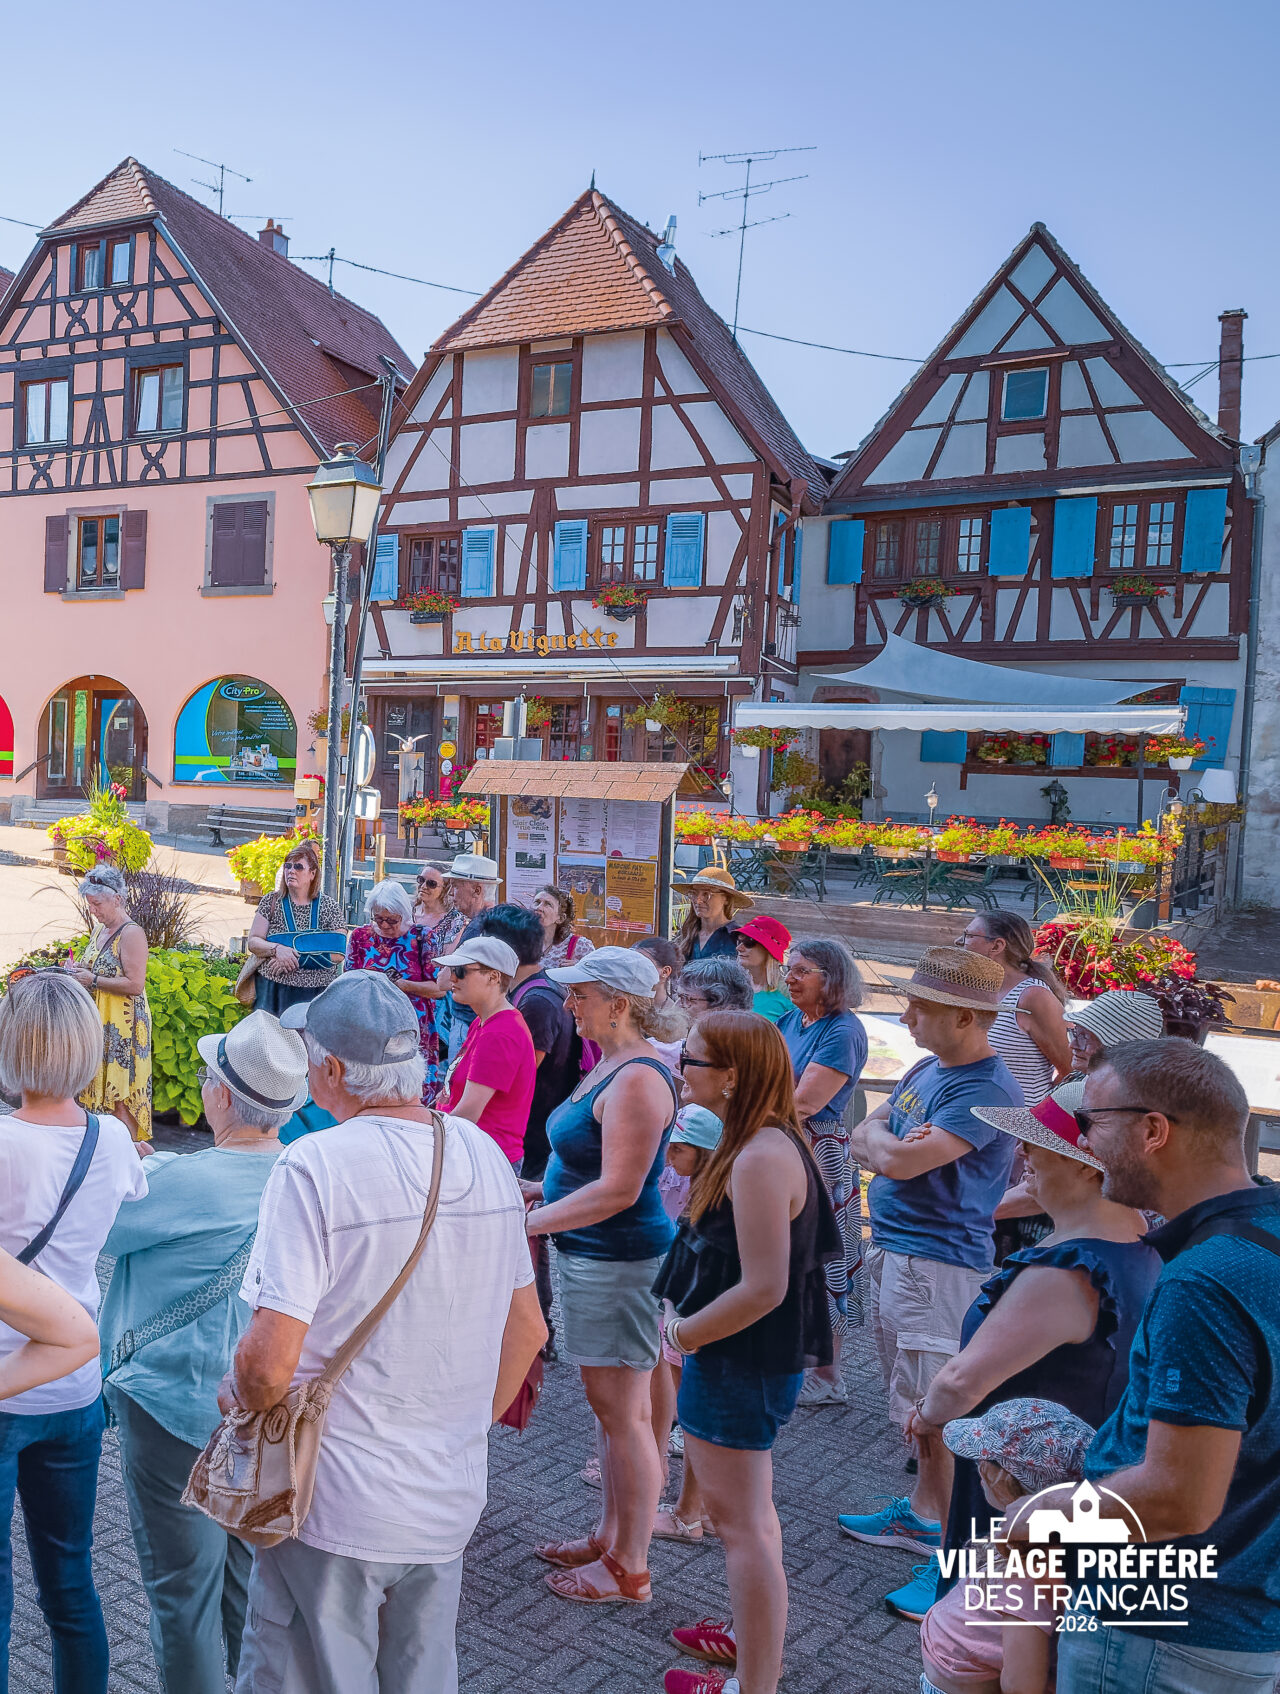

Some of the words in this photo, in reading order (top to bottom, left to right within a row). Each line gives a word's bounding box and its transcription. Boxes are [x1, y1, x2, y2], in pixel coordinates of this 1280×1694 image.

[453, 630, 475, 653] A
[479, 631, 504, 651] la
[509, 626, 619, 657] Vignette
